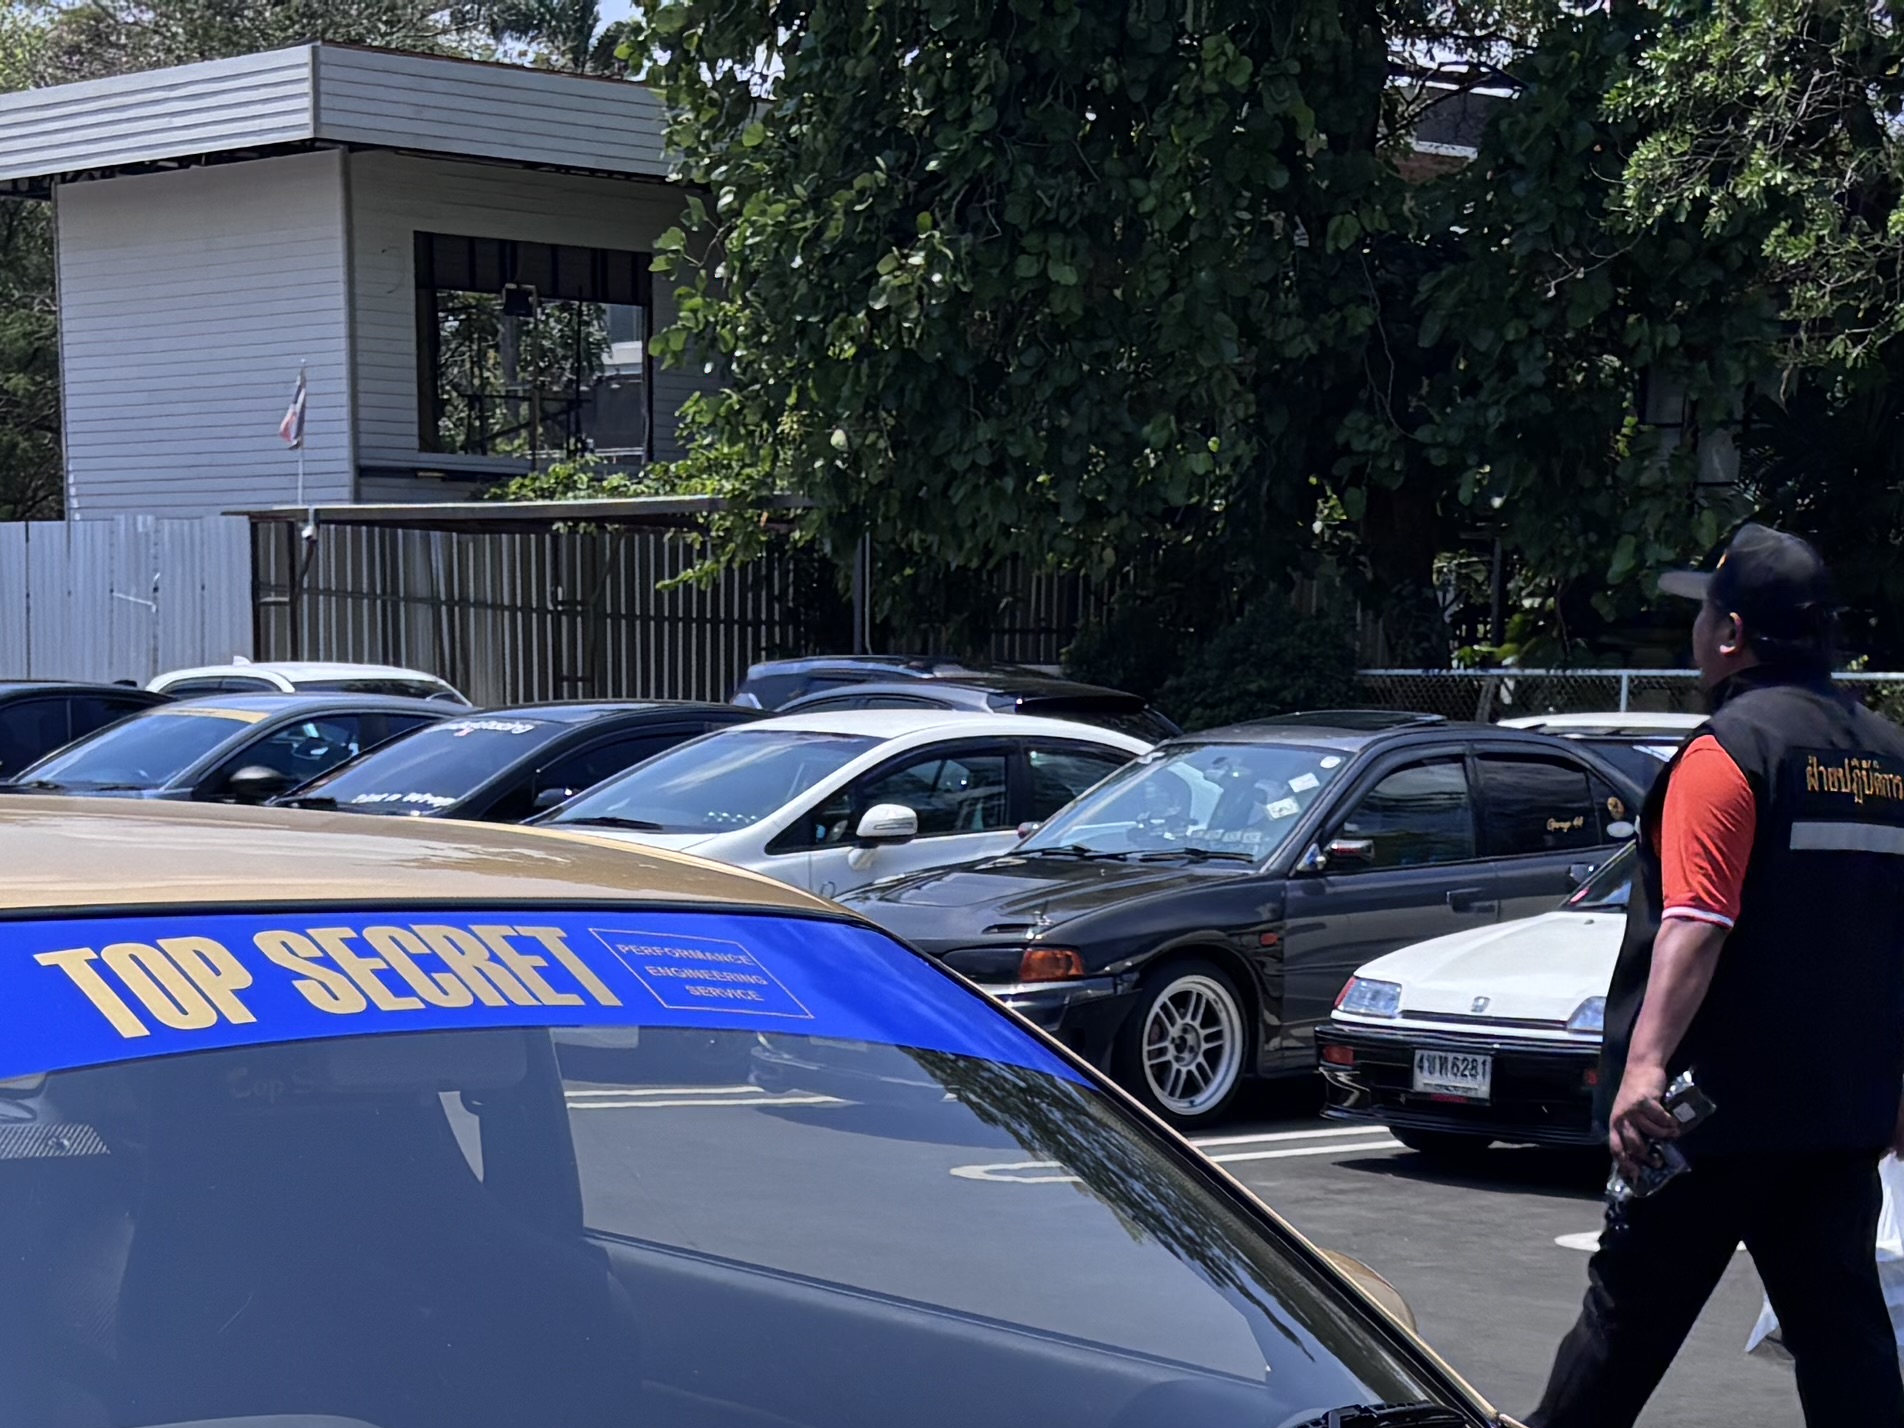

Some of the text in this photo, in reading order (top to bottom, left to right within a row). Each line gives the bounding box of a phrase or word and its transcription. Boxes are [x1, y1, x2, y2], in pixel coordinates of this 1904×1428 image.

[616, 943, 756, 967] PERFORMANCE
[33, 923, 623, 1038] TOP SECRET
[645, 965, 769, 985] ENGINEERING
[685, 984, 765, 1001] SERVICE
